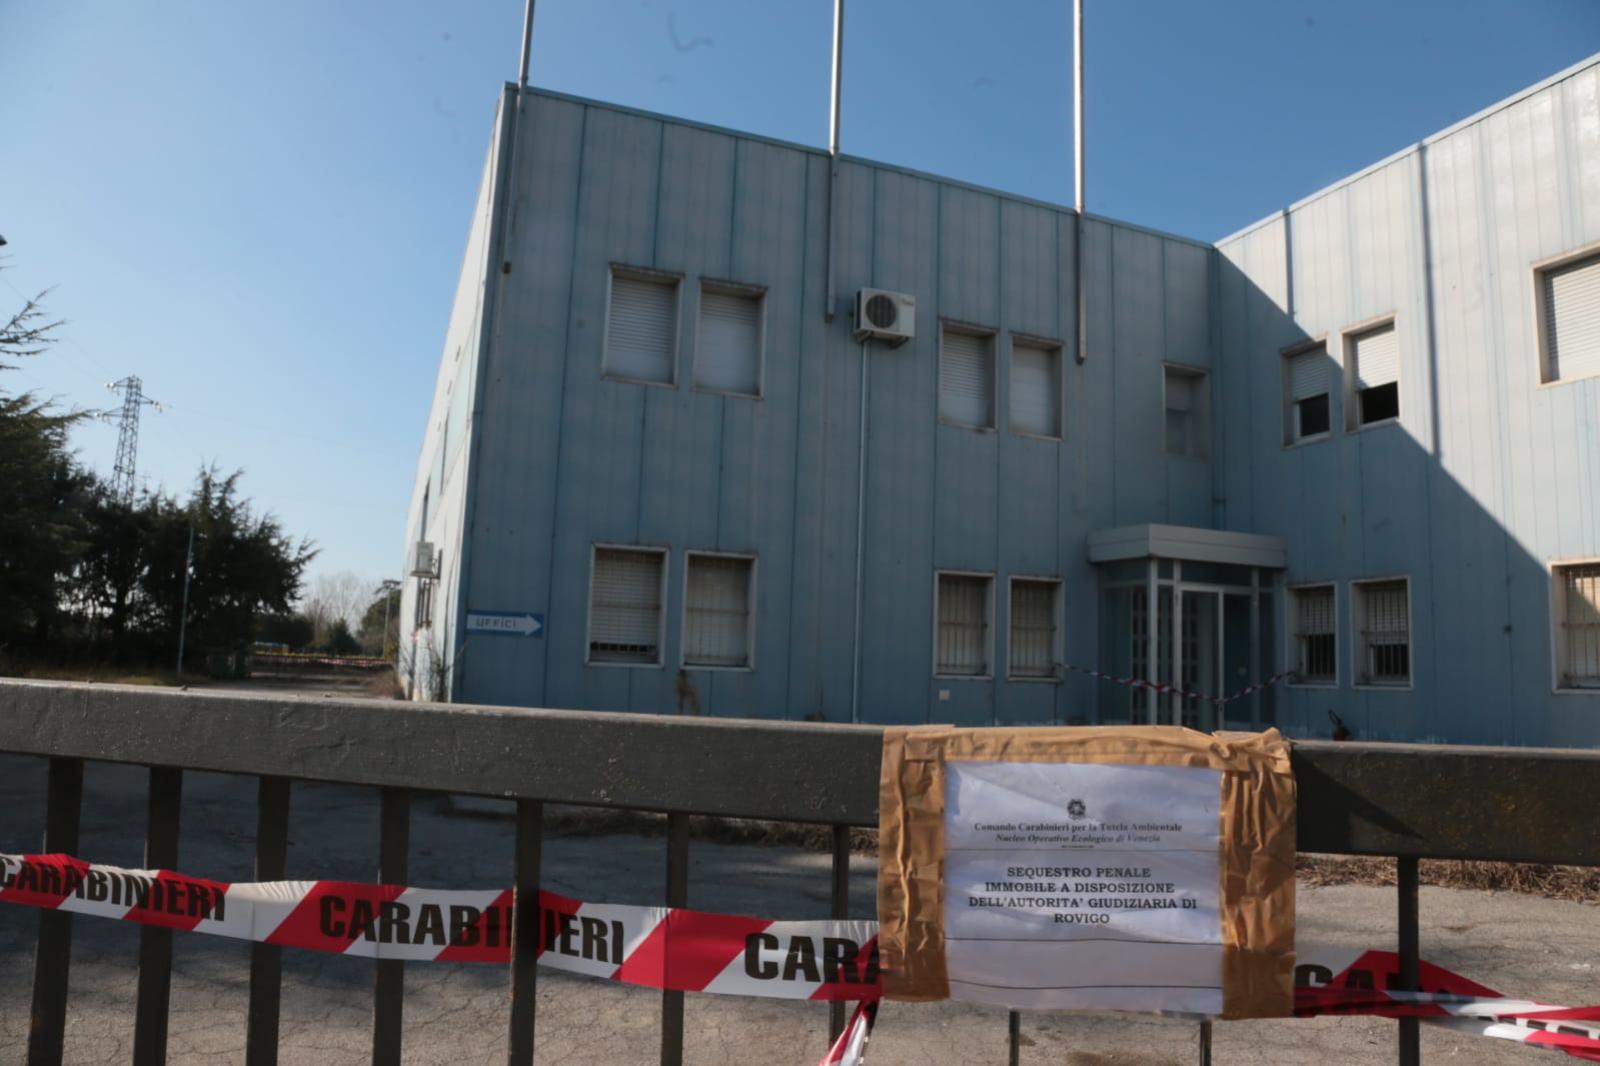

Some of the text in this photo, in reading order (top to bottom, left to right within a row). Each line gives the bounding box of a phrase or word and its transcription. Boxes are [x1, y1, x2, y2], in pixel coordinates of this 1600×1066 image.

[475, 618, 516, 629] UFFICI
[1018, 823, 1070, 832] Carabinieri
[1071, 825, 1086, 833] per
[1131, 823, 1182, 832] Ambientale
[1007, 867, 1151, 879] SEQUESTRO PENALE
[985, 882, 1175, 893] IMMOBILE A DISPOSIZIONE
[1088, 898, 1177, 909] GIUDIZIARIA
[1182, 899, 1197, 909] DI
[0, 855, 226, 922] CARABINIERI
[319, 894, 624, 965] CARABIIERI
[1054, 913, 1110, 924] ROVIGO
